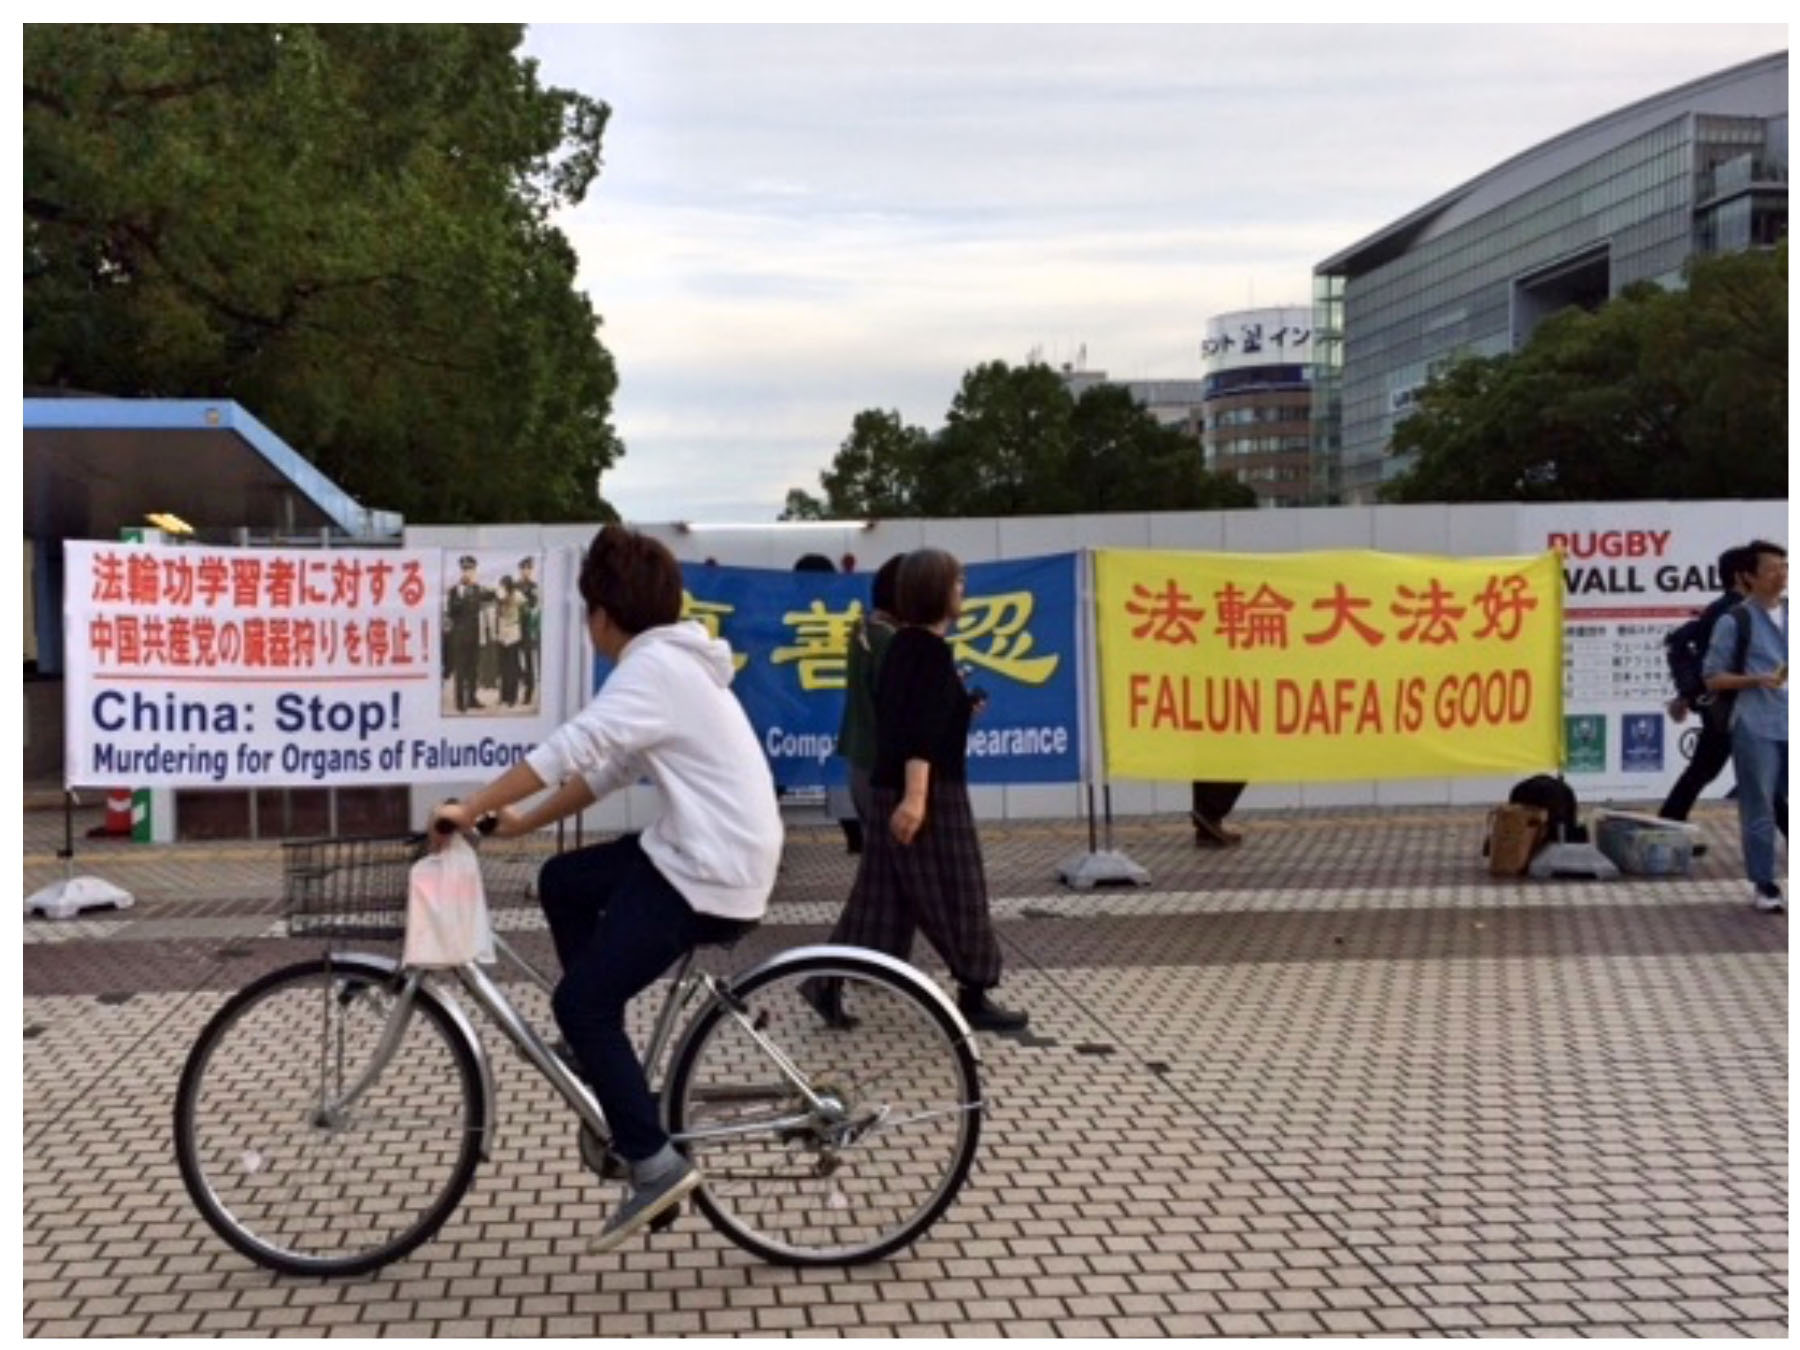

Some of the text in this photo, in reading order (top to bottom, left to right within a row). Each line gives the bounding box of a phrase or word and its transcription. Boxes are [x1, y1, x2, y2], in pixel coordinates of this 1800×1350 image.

[1548, 530, 1671, 558] RUGBY
[91, 553, 427, 608] 法輪功学習者に対する
[1655, 565, 1720, 593] GAL
[1124, 576, 1540, 650] 法輪大法好
[92, 690, 402, 738] China: Stop!
[1130, 678, 1260, 732] FALUN
[1275, 679, 1379, 735] DAFA
[1396, 676, 1425, 728] IS
[1436, 668, 1532, 728] GOOD
[93, 744, 227, 780] Murdering
[237, 743, 274, 774] for
[282, 745, 372, 777] Organs
[379, 741, 404, 770] of
[766, 727, 838, 765] Comp
